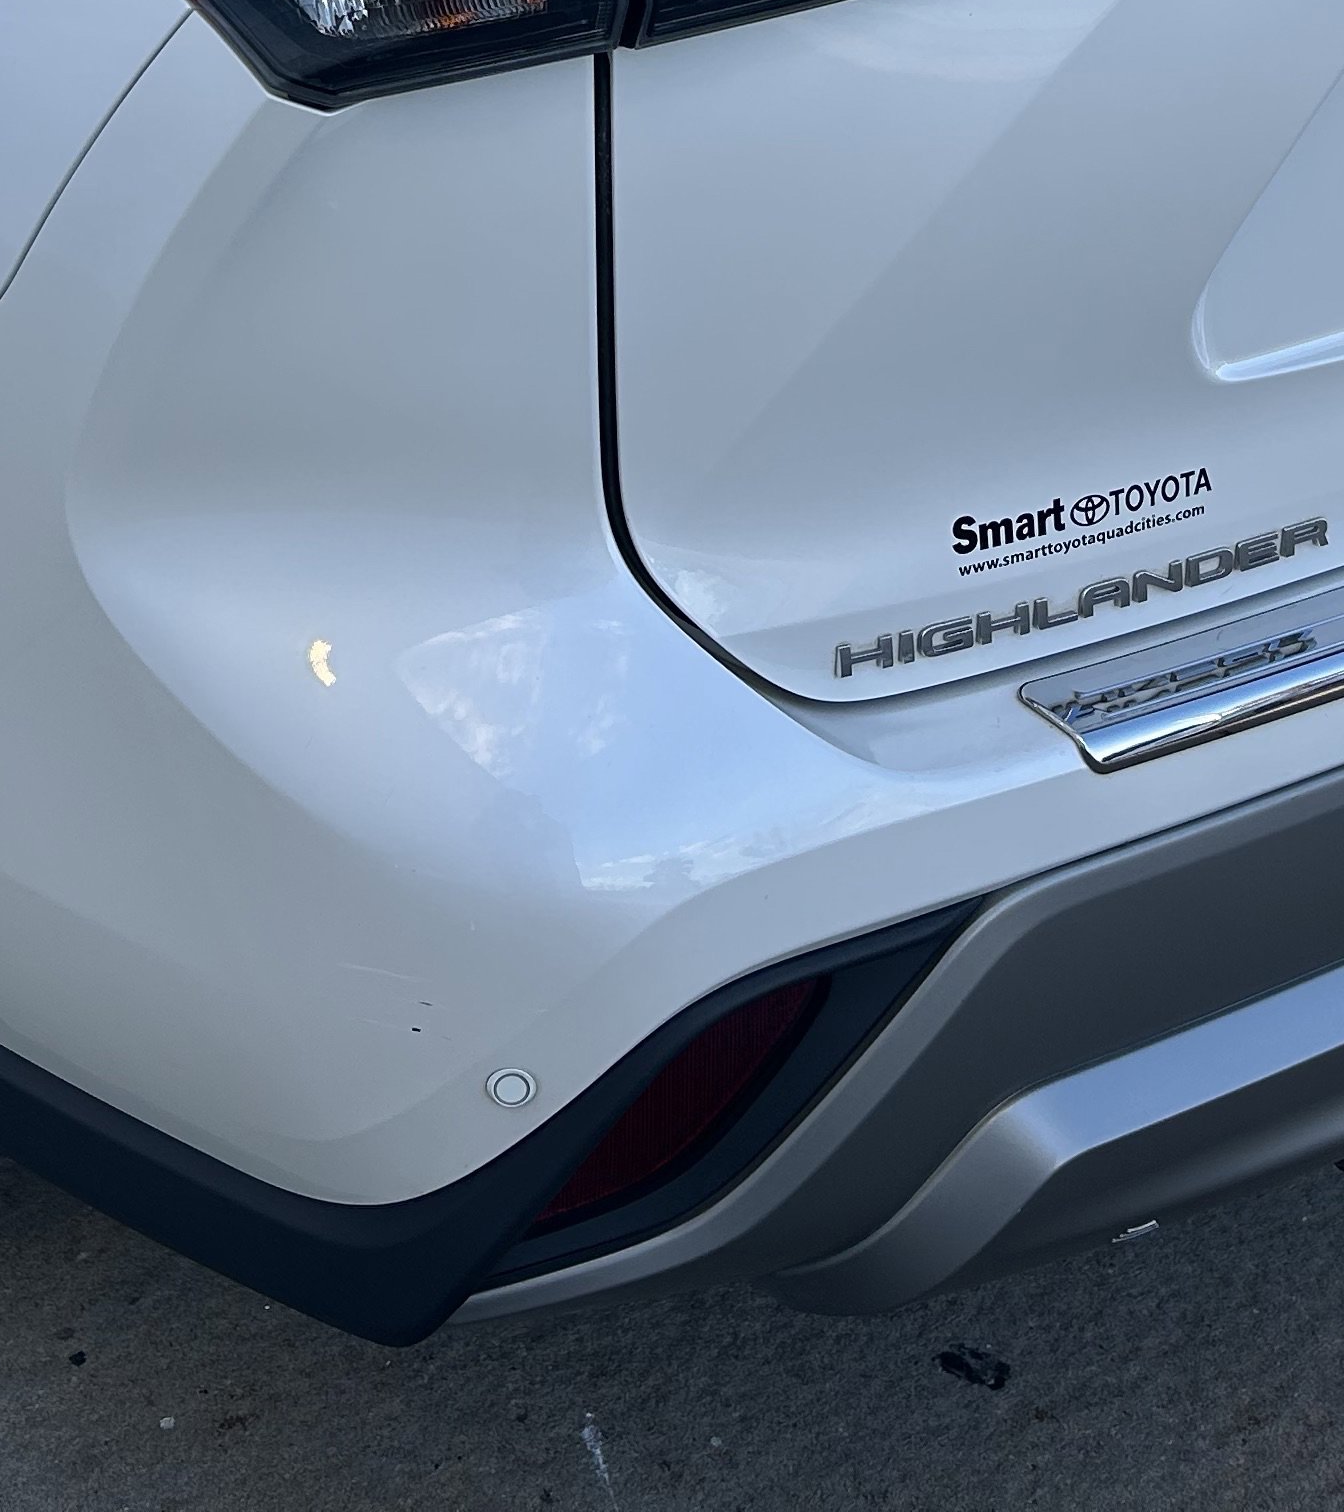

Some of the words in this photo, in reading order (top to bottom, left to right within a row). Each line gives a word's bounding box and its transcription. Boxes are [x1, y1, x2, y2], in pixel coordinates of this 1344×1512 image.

[952, 497, 1066, 555] Smart
[1109, 467, 1212, 516] TOYOTA
[958, 505, 1205, 577] www.smarttoyotaquadcities.com
[834, 516, 1329, 679] HIGHLANDER
